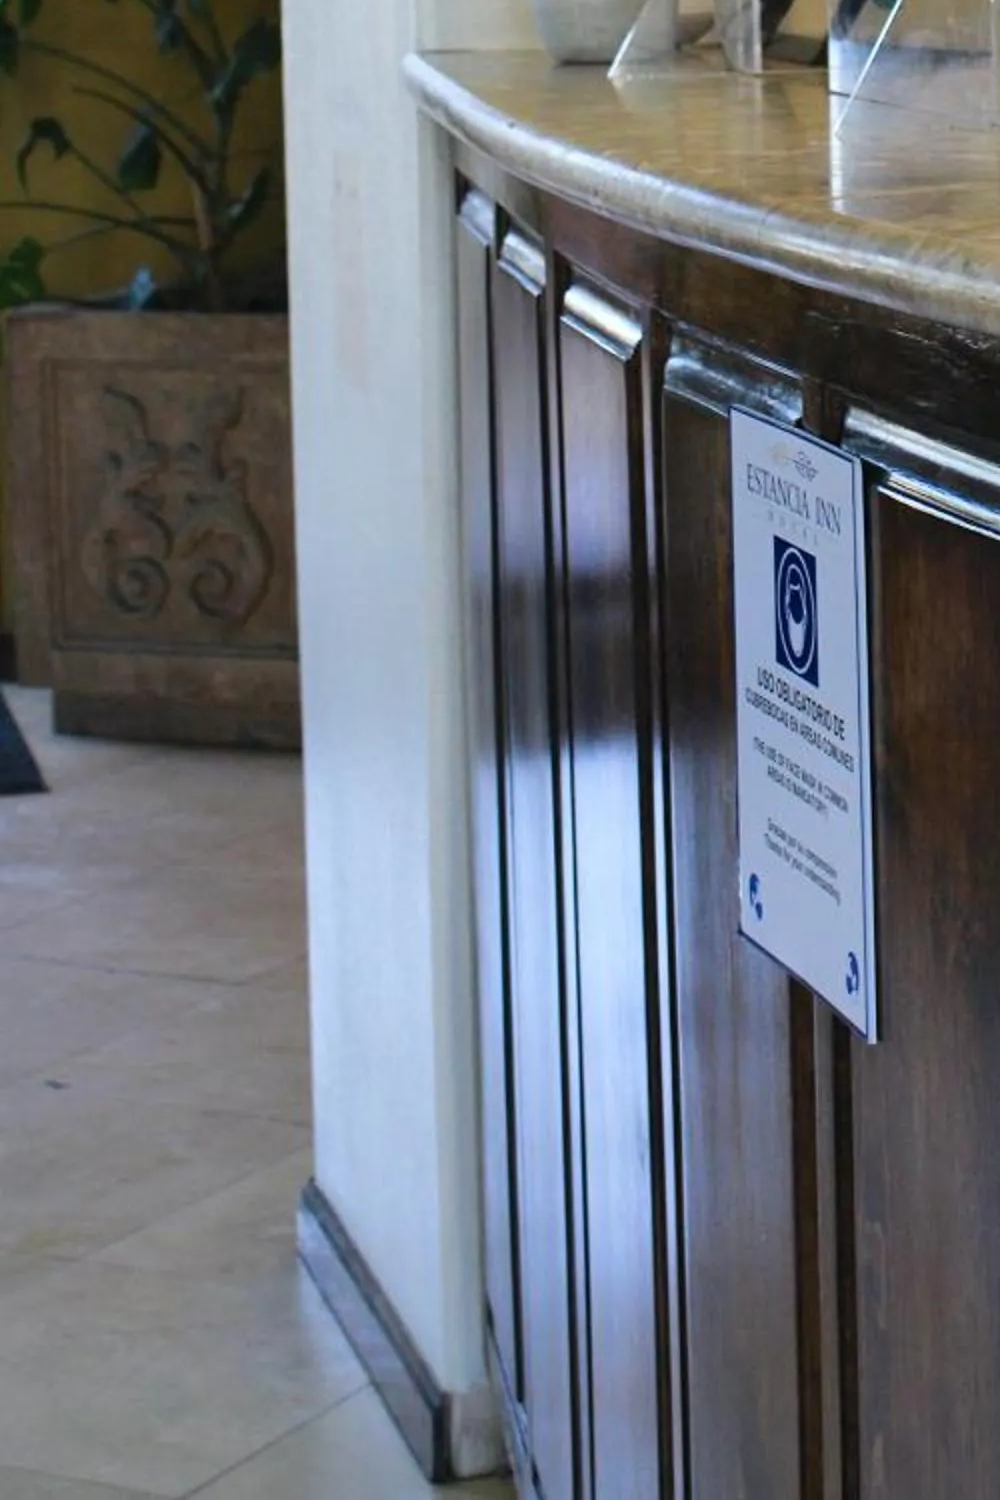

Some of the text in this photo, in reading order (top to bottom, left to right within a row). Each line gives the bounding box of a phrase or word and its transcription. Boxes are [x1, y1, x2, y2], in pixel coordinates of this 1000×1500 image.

[747, 463, 810, 520] ESTANCIA
[816, 496, 841, 535] INN
[758, 666, 845, 741] USO OBLIGATORIO DE
